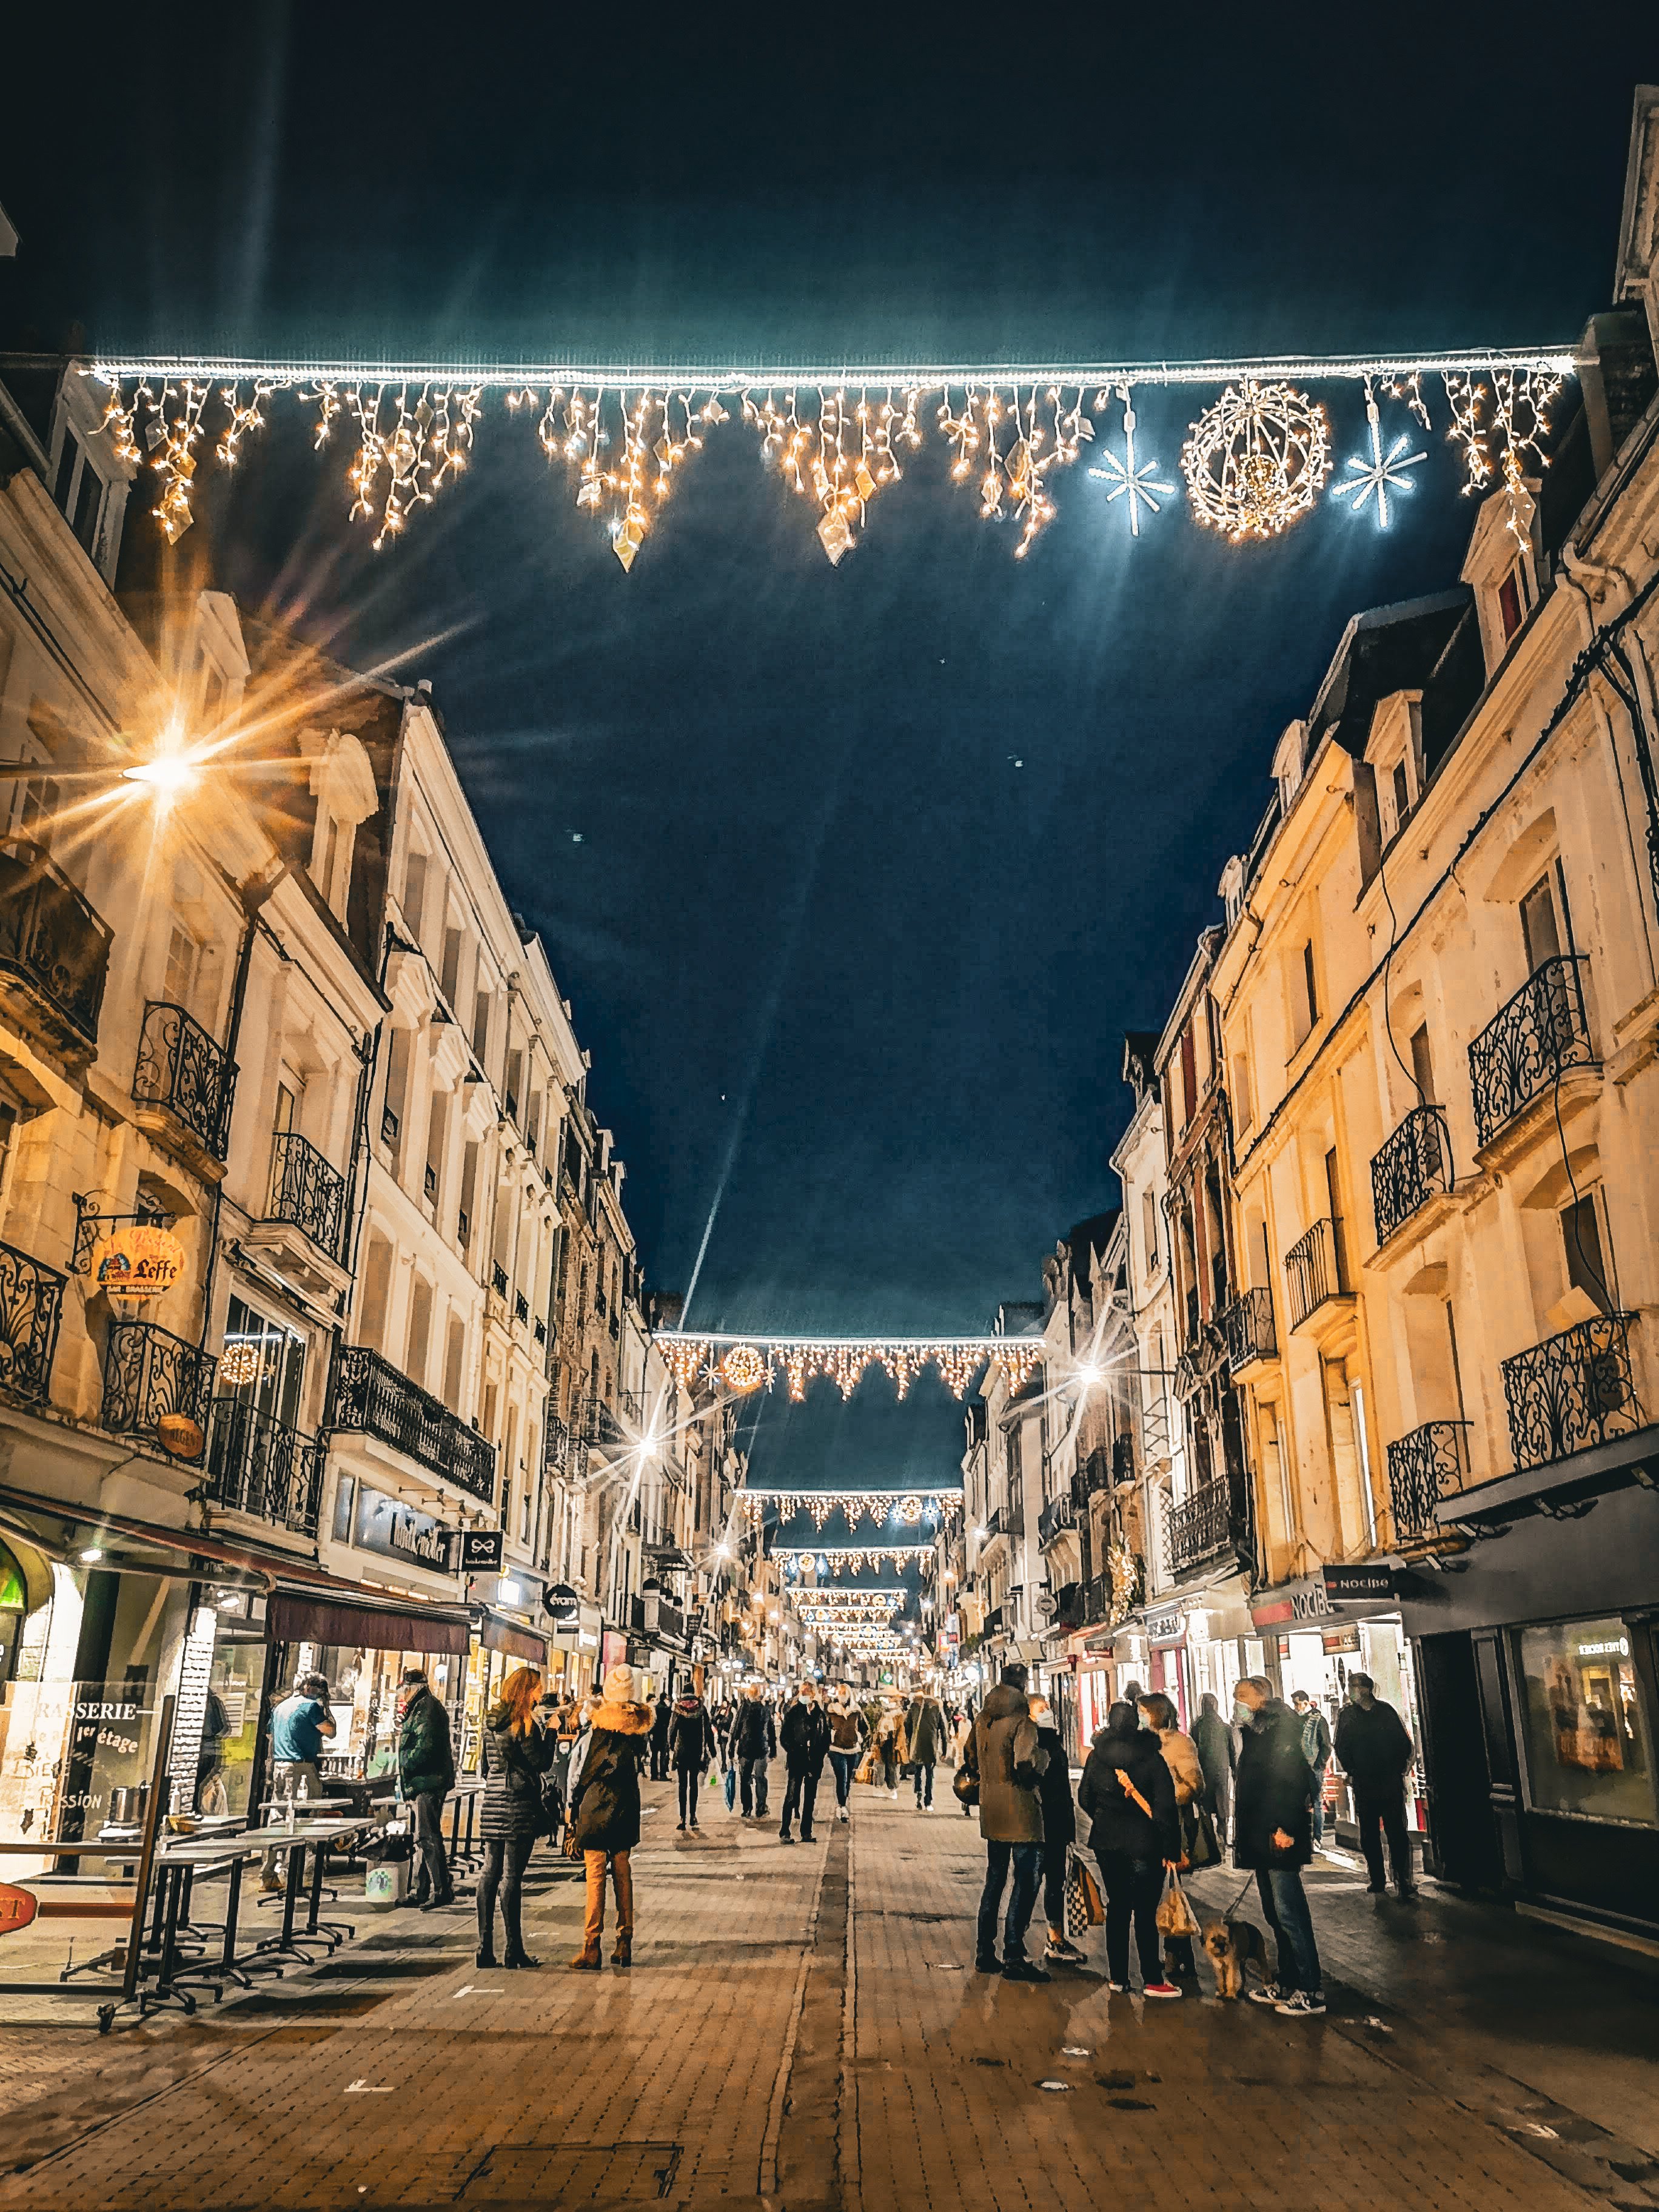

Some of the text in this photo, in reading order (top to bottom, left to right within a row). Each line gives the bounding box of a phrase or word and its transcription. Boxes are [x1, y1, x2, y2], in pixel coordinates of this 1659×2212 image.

[133, 1258, 178, 1281] Leffe
[24, 1702, 137, 1720] RASERIE
[97, 1728, 139, 1754] étage
